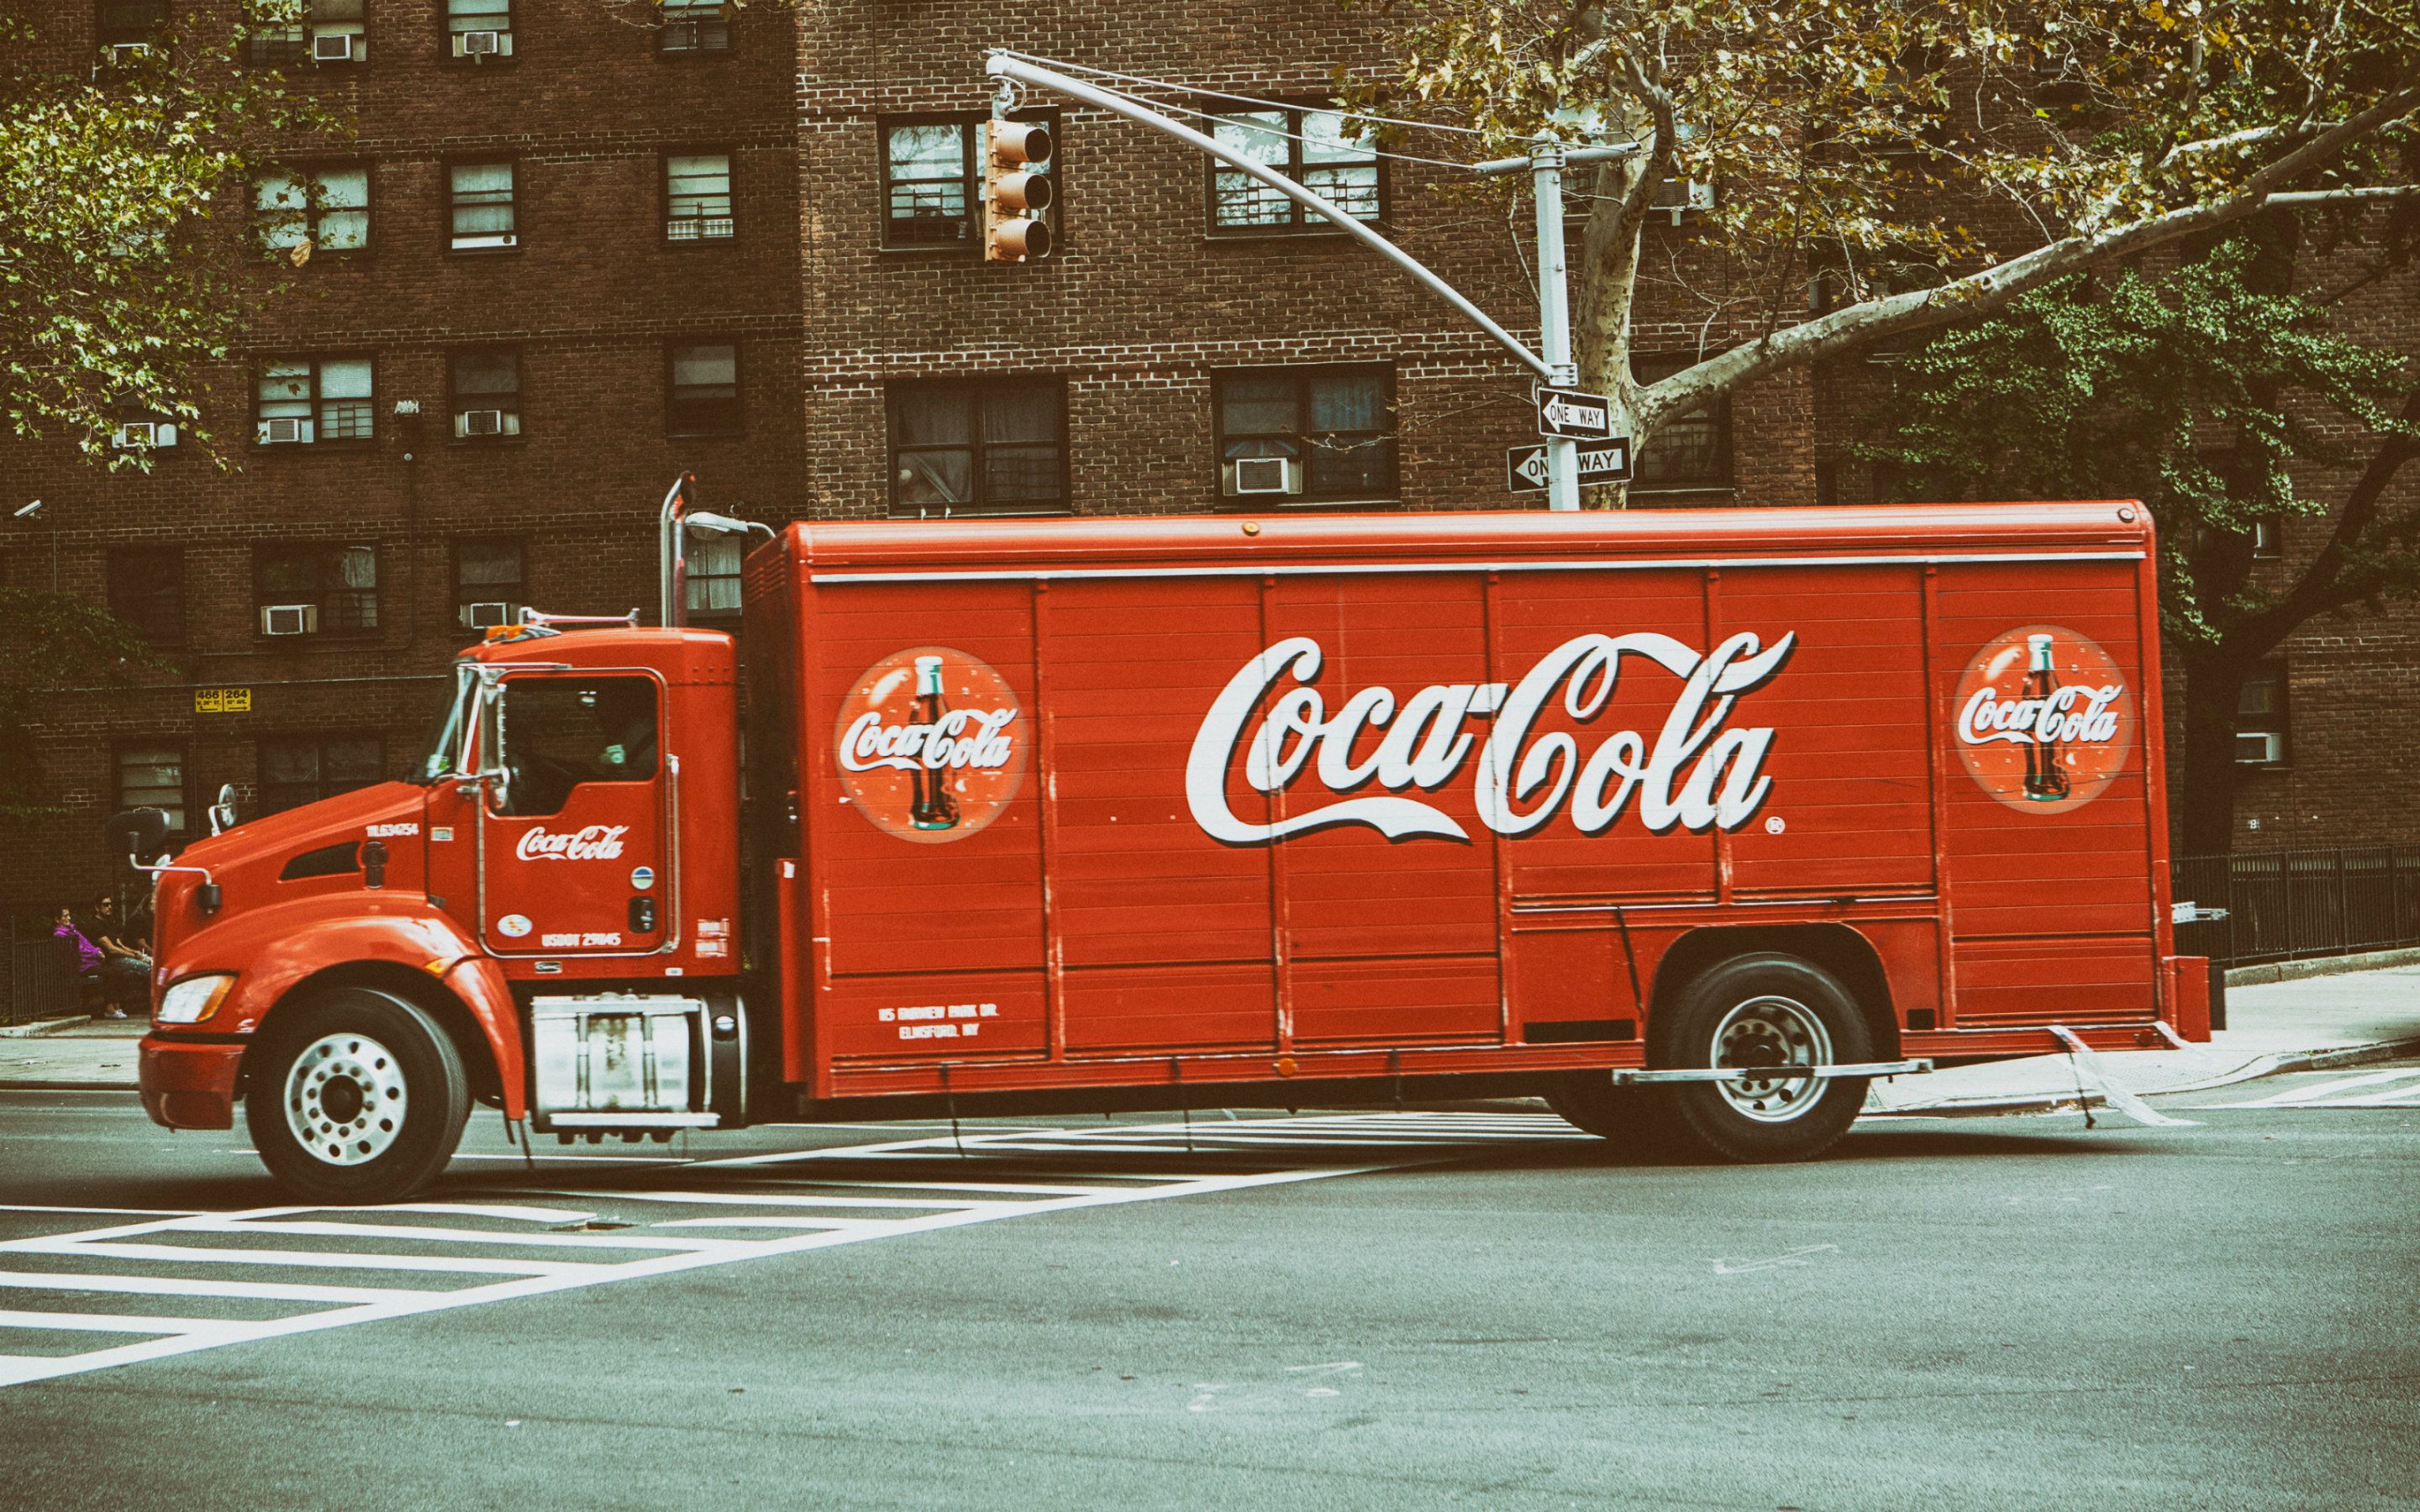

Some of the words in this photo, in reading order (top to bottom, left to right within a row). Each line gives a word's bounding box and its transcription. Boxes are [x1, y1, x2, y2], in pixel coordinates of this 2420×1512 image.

[1550, 405, 1570, 423] ONE
[1579, 408, 1600, 427] WAY
[1528, 459, 1549, 476] ON
[1577, 451, 1614, 471] WAY
[197, 690, 219, 699] 466
[225, 690, 248, 698] 264
[1958, 685, 2123, 745] Coca-Cola
[839, 707, 1018, 772] Coca-Cola
[1186, 630, 1795, 843] Coca-Cola
[516, 825, 630, 860] Coca-Cola
[541, 933, 581, 947] USDOT
